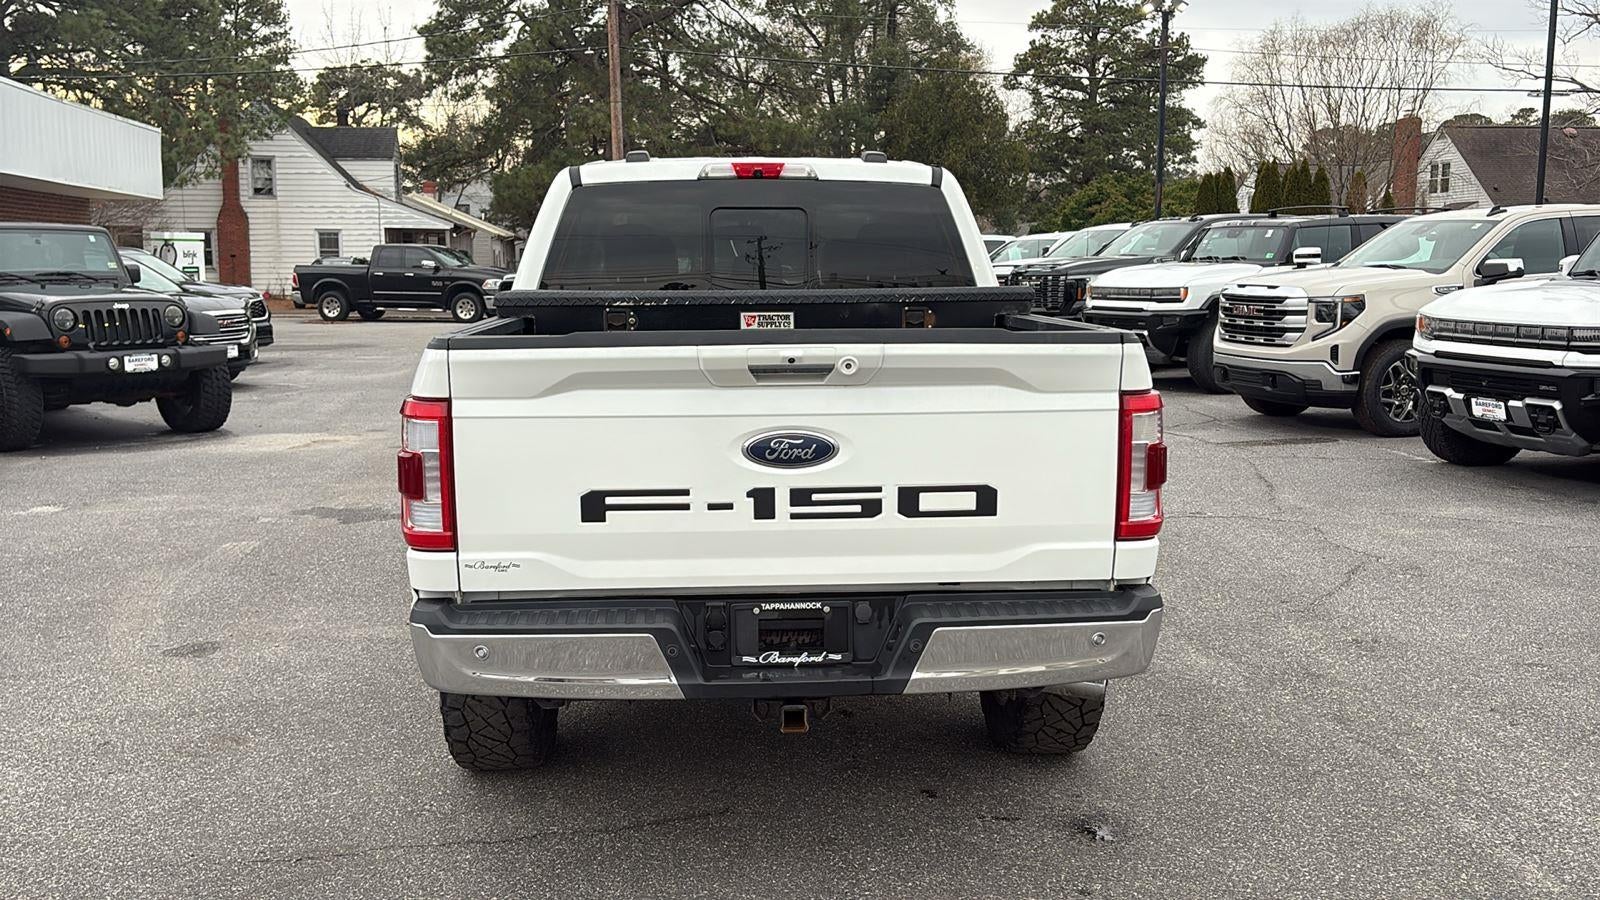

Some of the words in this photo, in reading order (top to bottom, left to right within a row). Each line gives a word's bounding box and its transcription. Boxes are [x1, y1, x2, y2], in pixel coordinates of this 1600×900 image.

[113, 302, 130, 310] Jeep
[1232, 304, 1264, 317] GMC
[1475, 400, 1503, 410] BAREFORD
[765, 438, 817, 460] Ford
[580, 485, 998, 523] F-150
[473, 560, 513, 572] Bareford
[760, 602, 822, 610] TAPPAHANNOCK
[759, 651, 827, 667] Bareford
